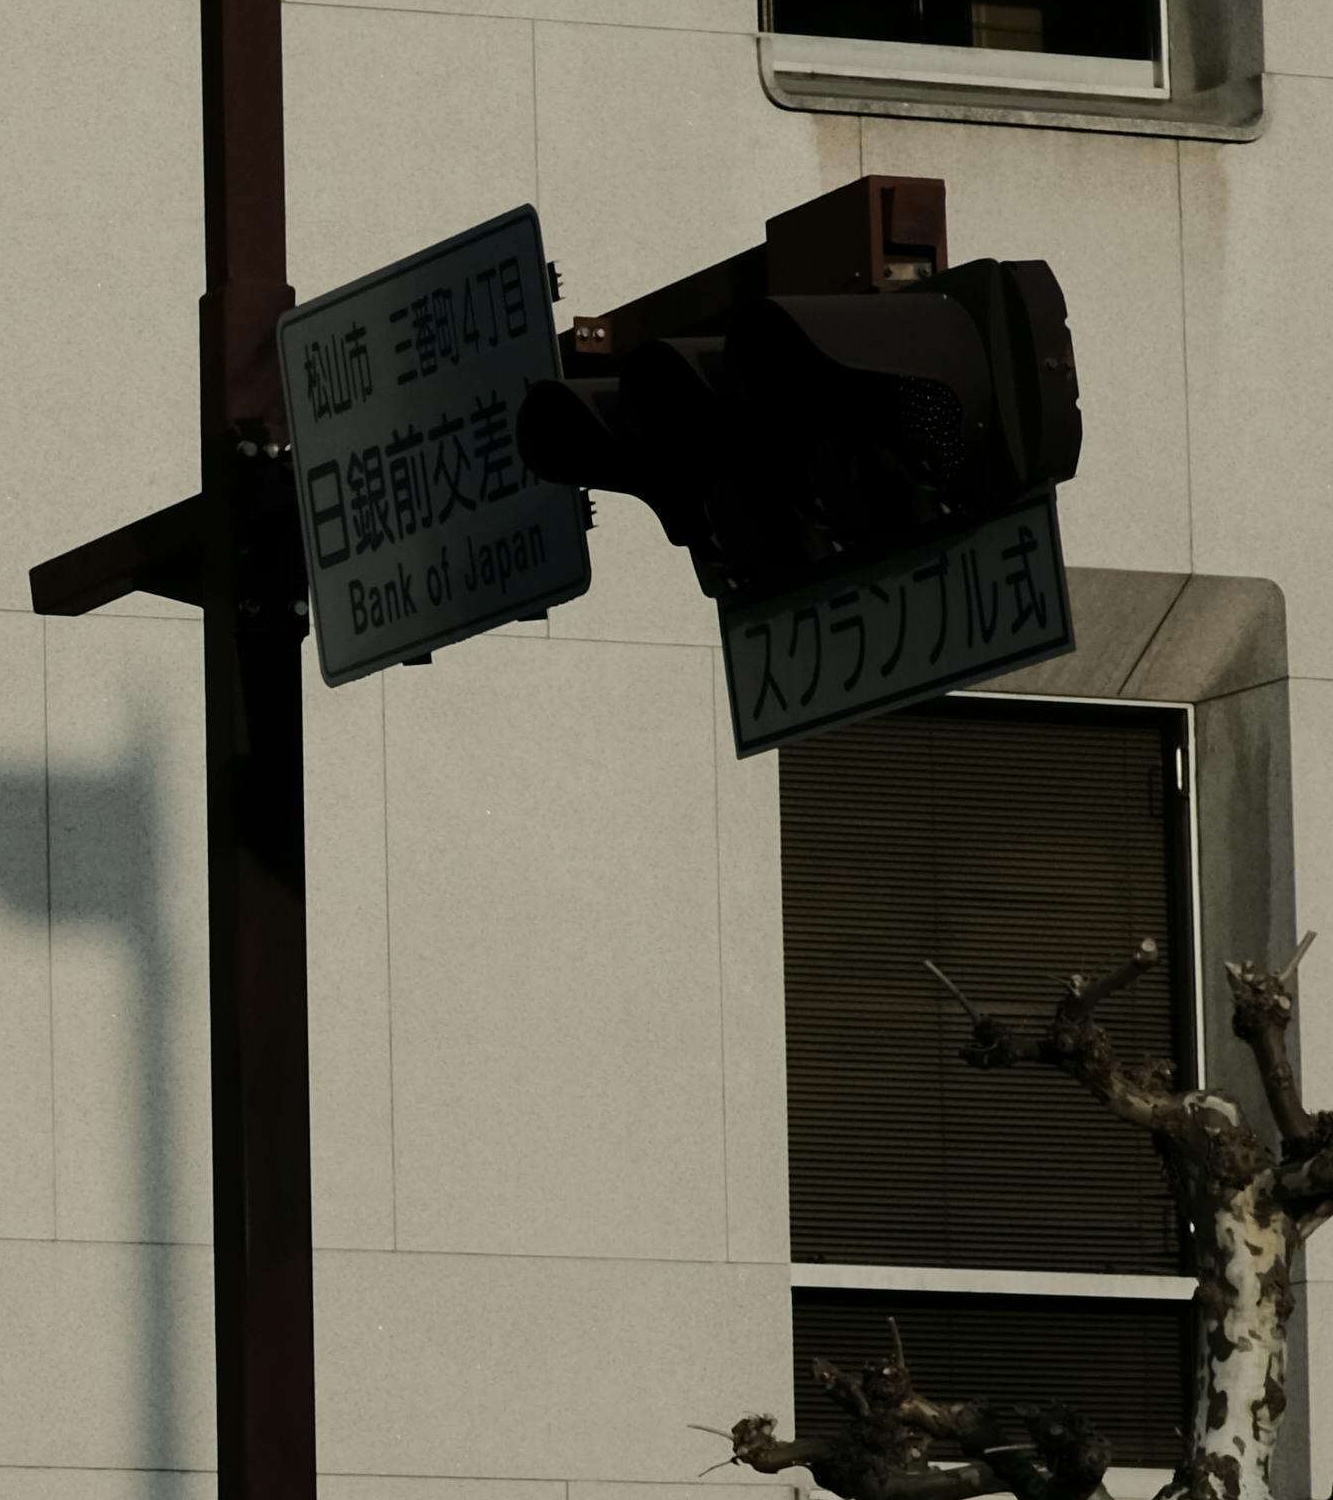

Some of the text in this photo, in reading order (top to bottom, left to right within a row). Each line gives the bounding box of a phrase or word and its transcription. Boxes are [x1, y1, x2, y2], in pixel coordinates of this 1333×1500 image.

[306, 256, 528, 423] 松山市 三番町4丁目
[307, 377, 539, 568] 日銀前交差
[349, 521, 546, 635] Bank of Japan
[747, 526, 1047, 721] スクランブル式
